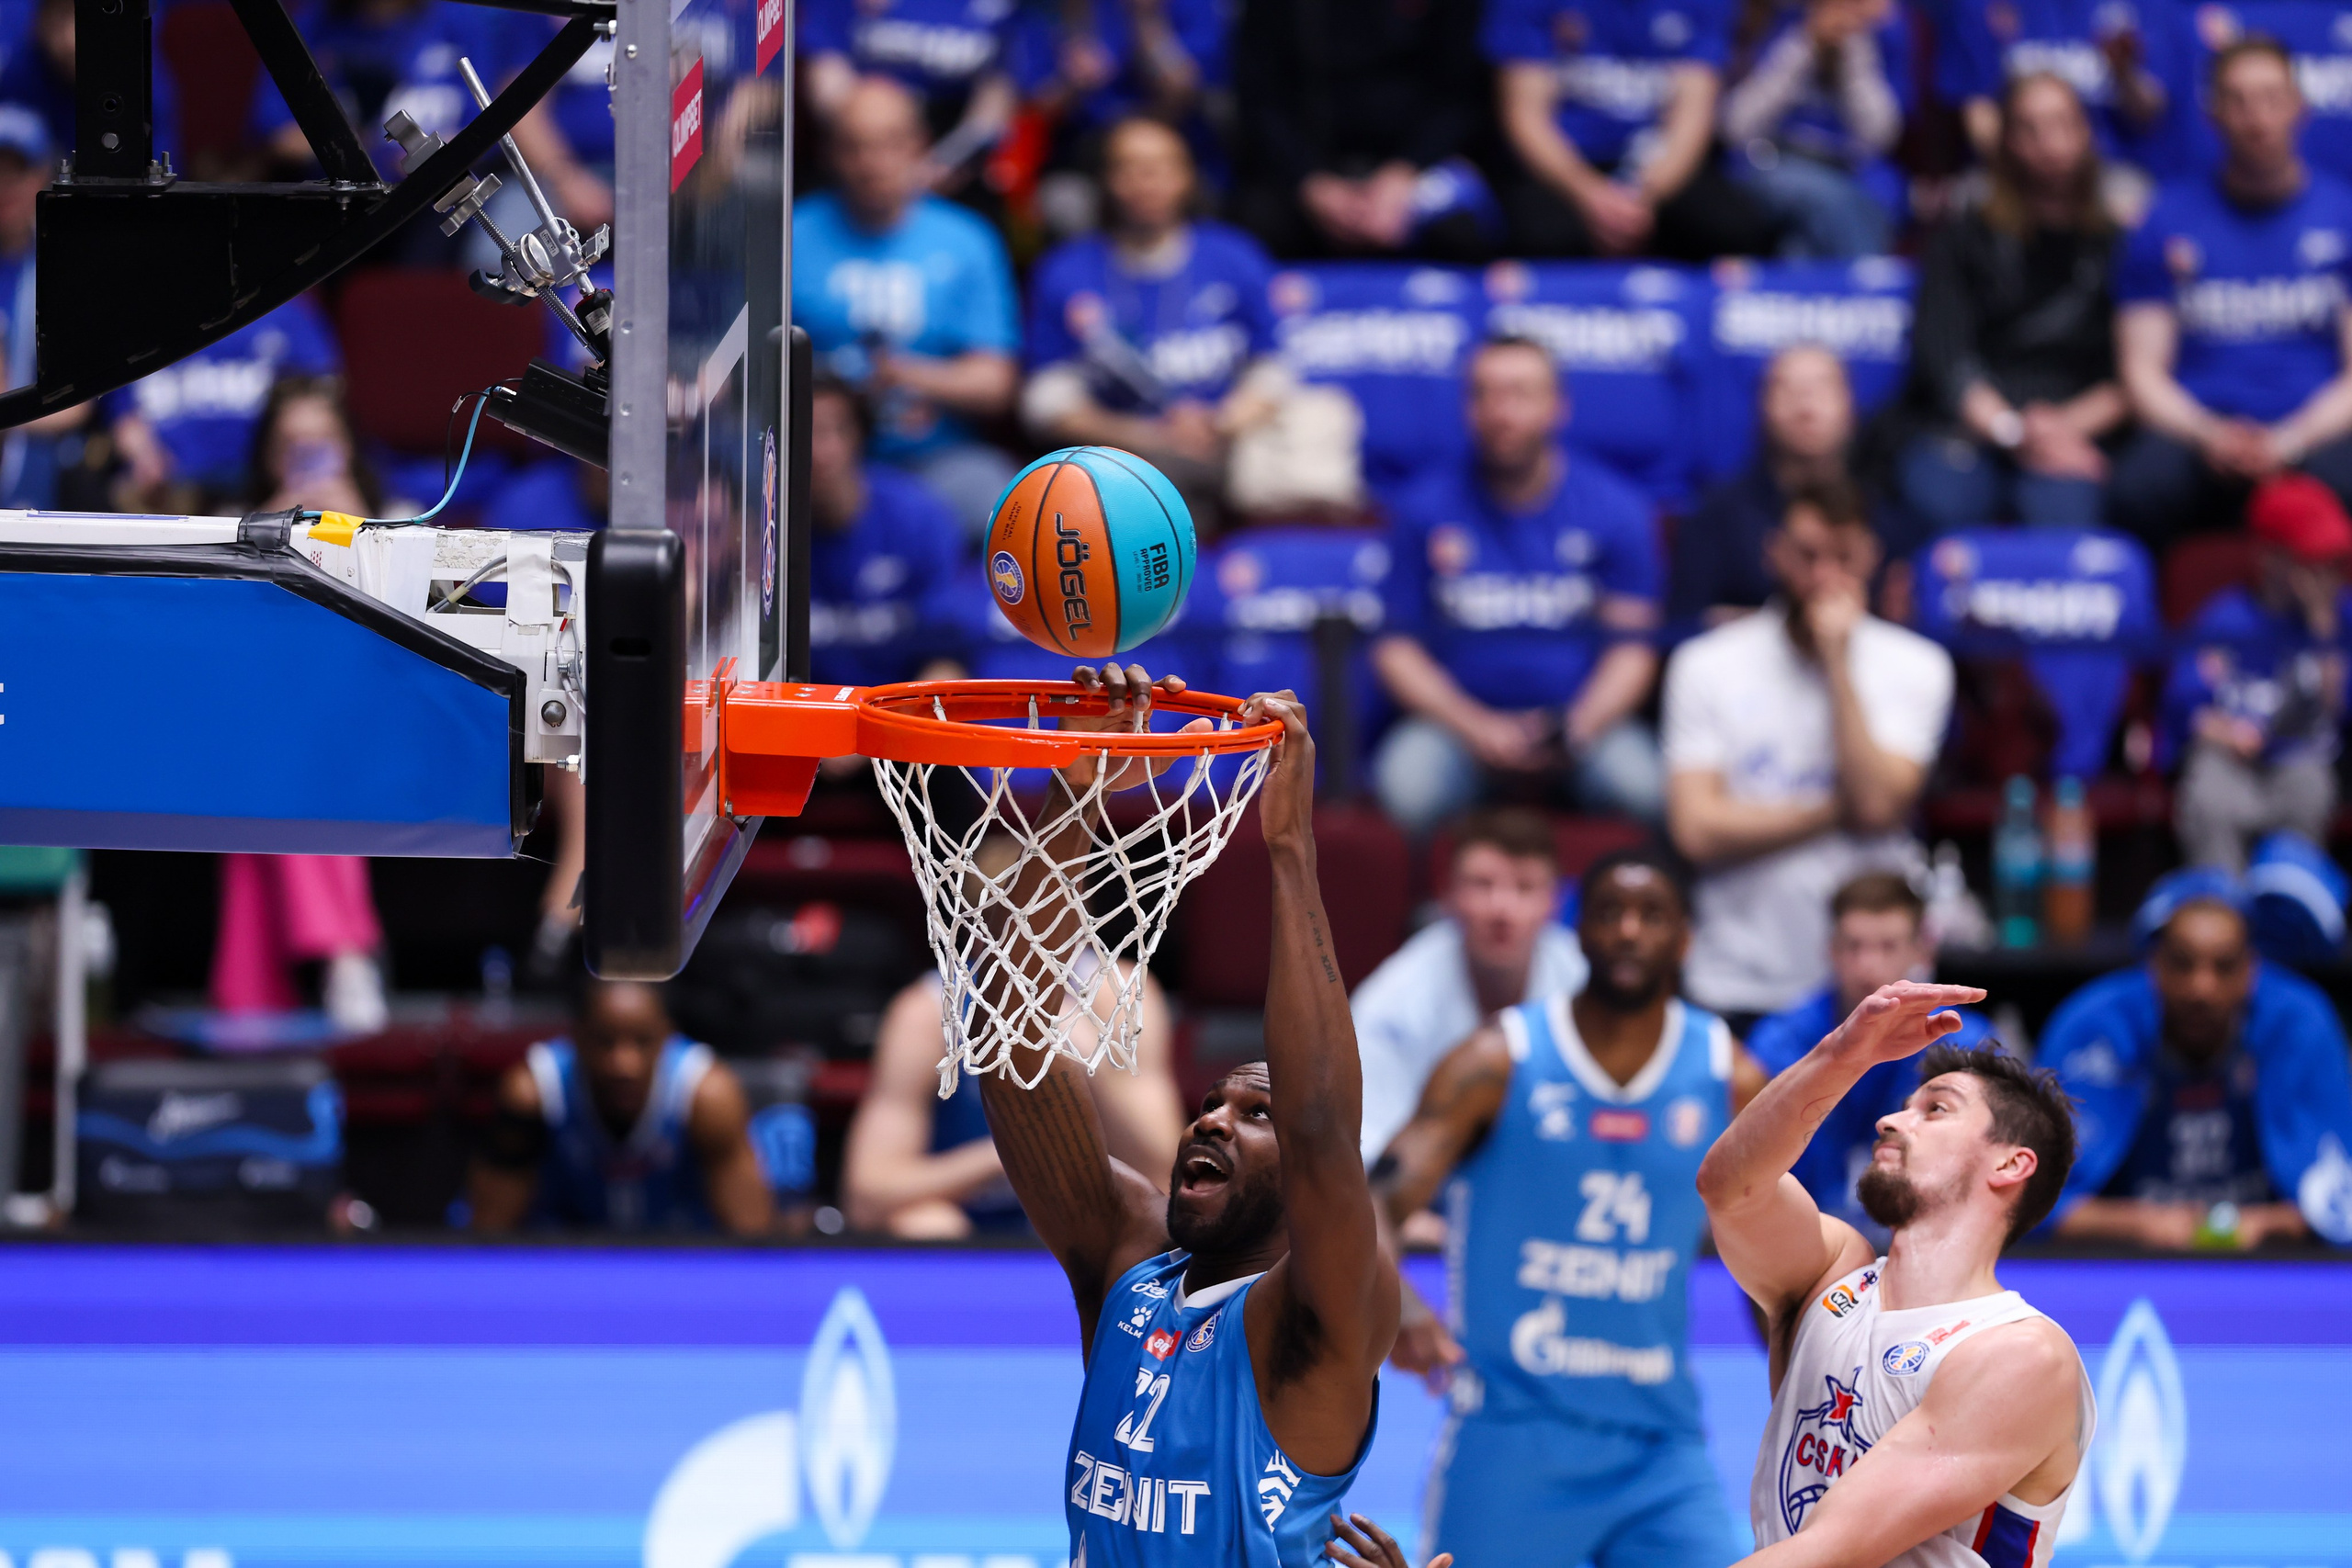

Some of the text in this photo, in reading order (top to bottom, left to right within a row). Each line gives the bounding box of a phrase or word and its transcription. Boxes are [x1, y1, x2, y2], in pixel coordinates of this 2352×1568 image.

[673, 88, 702, 158] OLIMPBET
[1055, 512, 1091, 641] JÖGEL
[1140, 548, 1152, 592] APPROVED
[1149, 542, 1170, 589] FIBA
[1577, 1172, 1651, 1242] 24
[1518, 1239, 1676, 1302] ZENIT
[1117, 1321, 1144, 1338] KELM
[1114, 1367, 1170, 1452] 22
[1071, 1450, 1211, 1534] ZENIT
